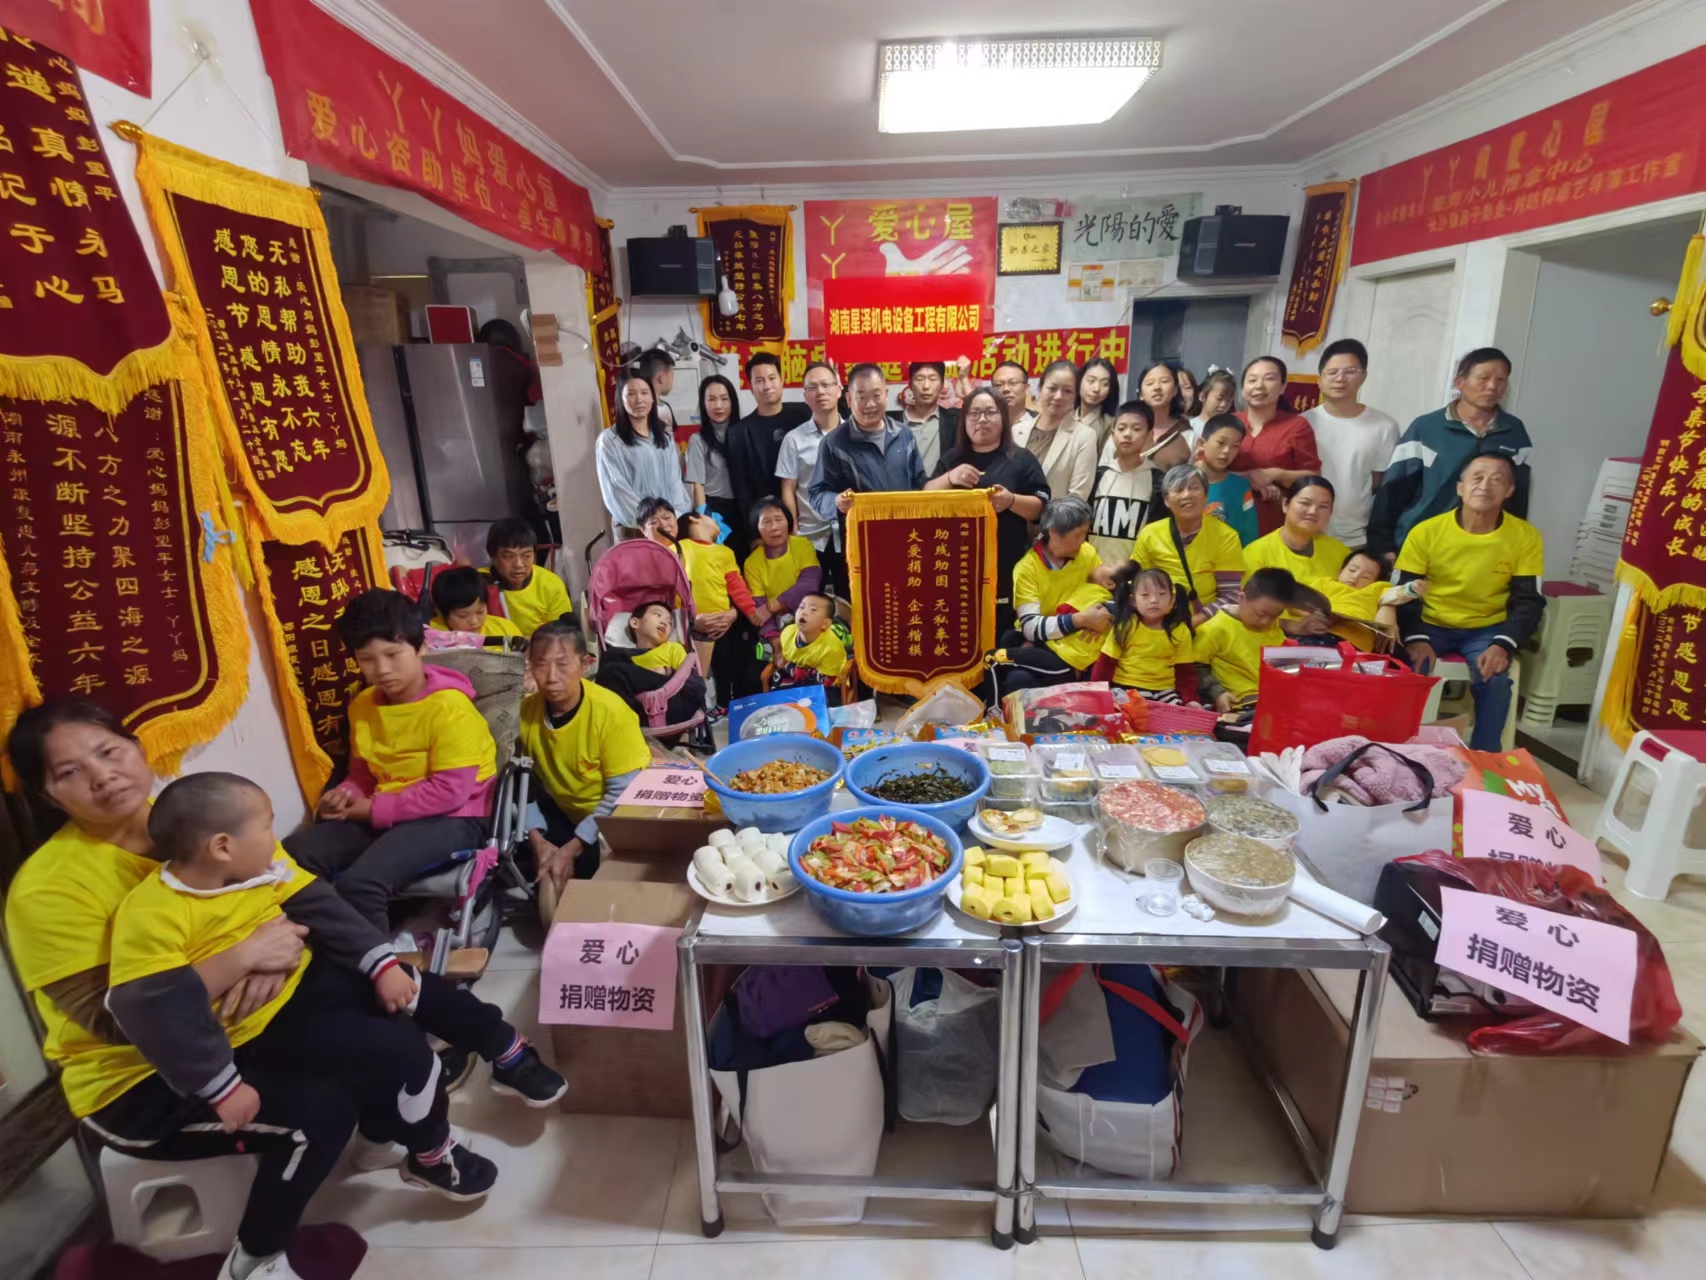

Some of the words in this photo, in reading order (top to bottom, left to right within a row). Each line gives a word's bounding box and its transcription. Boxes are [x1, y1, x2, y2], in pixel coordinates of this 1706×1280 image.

[868, 203, 974, 242] 爱心屋
[1073, 203, 1181, 247] 光陽的愛
[239, 234, 312, 462] 您的恩情永不忘
[829, 305, 980, 336] 湖南星泽机电设备工程有限公司
[213, 228, 294, 473] 感恩节感恩有您
[268, 240, 330, 460] 无私帮助我六年
[46, 401, 106, 695] 源不断坚持公益六年
[95, 425, 153, 687] 八方之力聚四海之源
[906, 528, 924, 588] 大爱捐助
[933, 528, 950, 588] 助残助困
[907, 598, 924, 657] 企业楷模
[933, 599, 950, 657] 无私奉献
[633, 789, 704, 802] 捐赠物资
[662, 774, 698, 786] 爱心
[1508, 812, 1567, 849] 爱心
[580, 938, 640, 966] 爱心
[1495, 906, 1580, 948] 爱心
[559, 983, 656, 1013] 捐赠物资
[1466, 933, 1600, 1014] 捐赠物资
